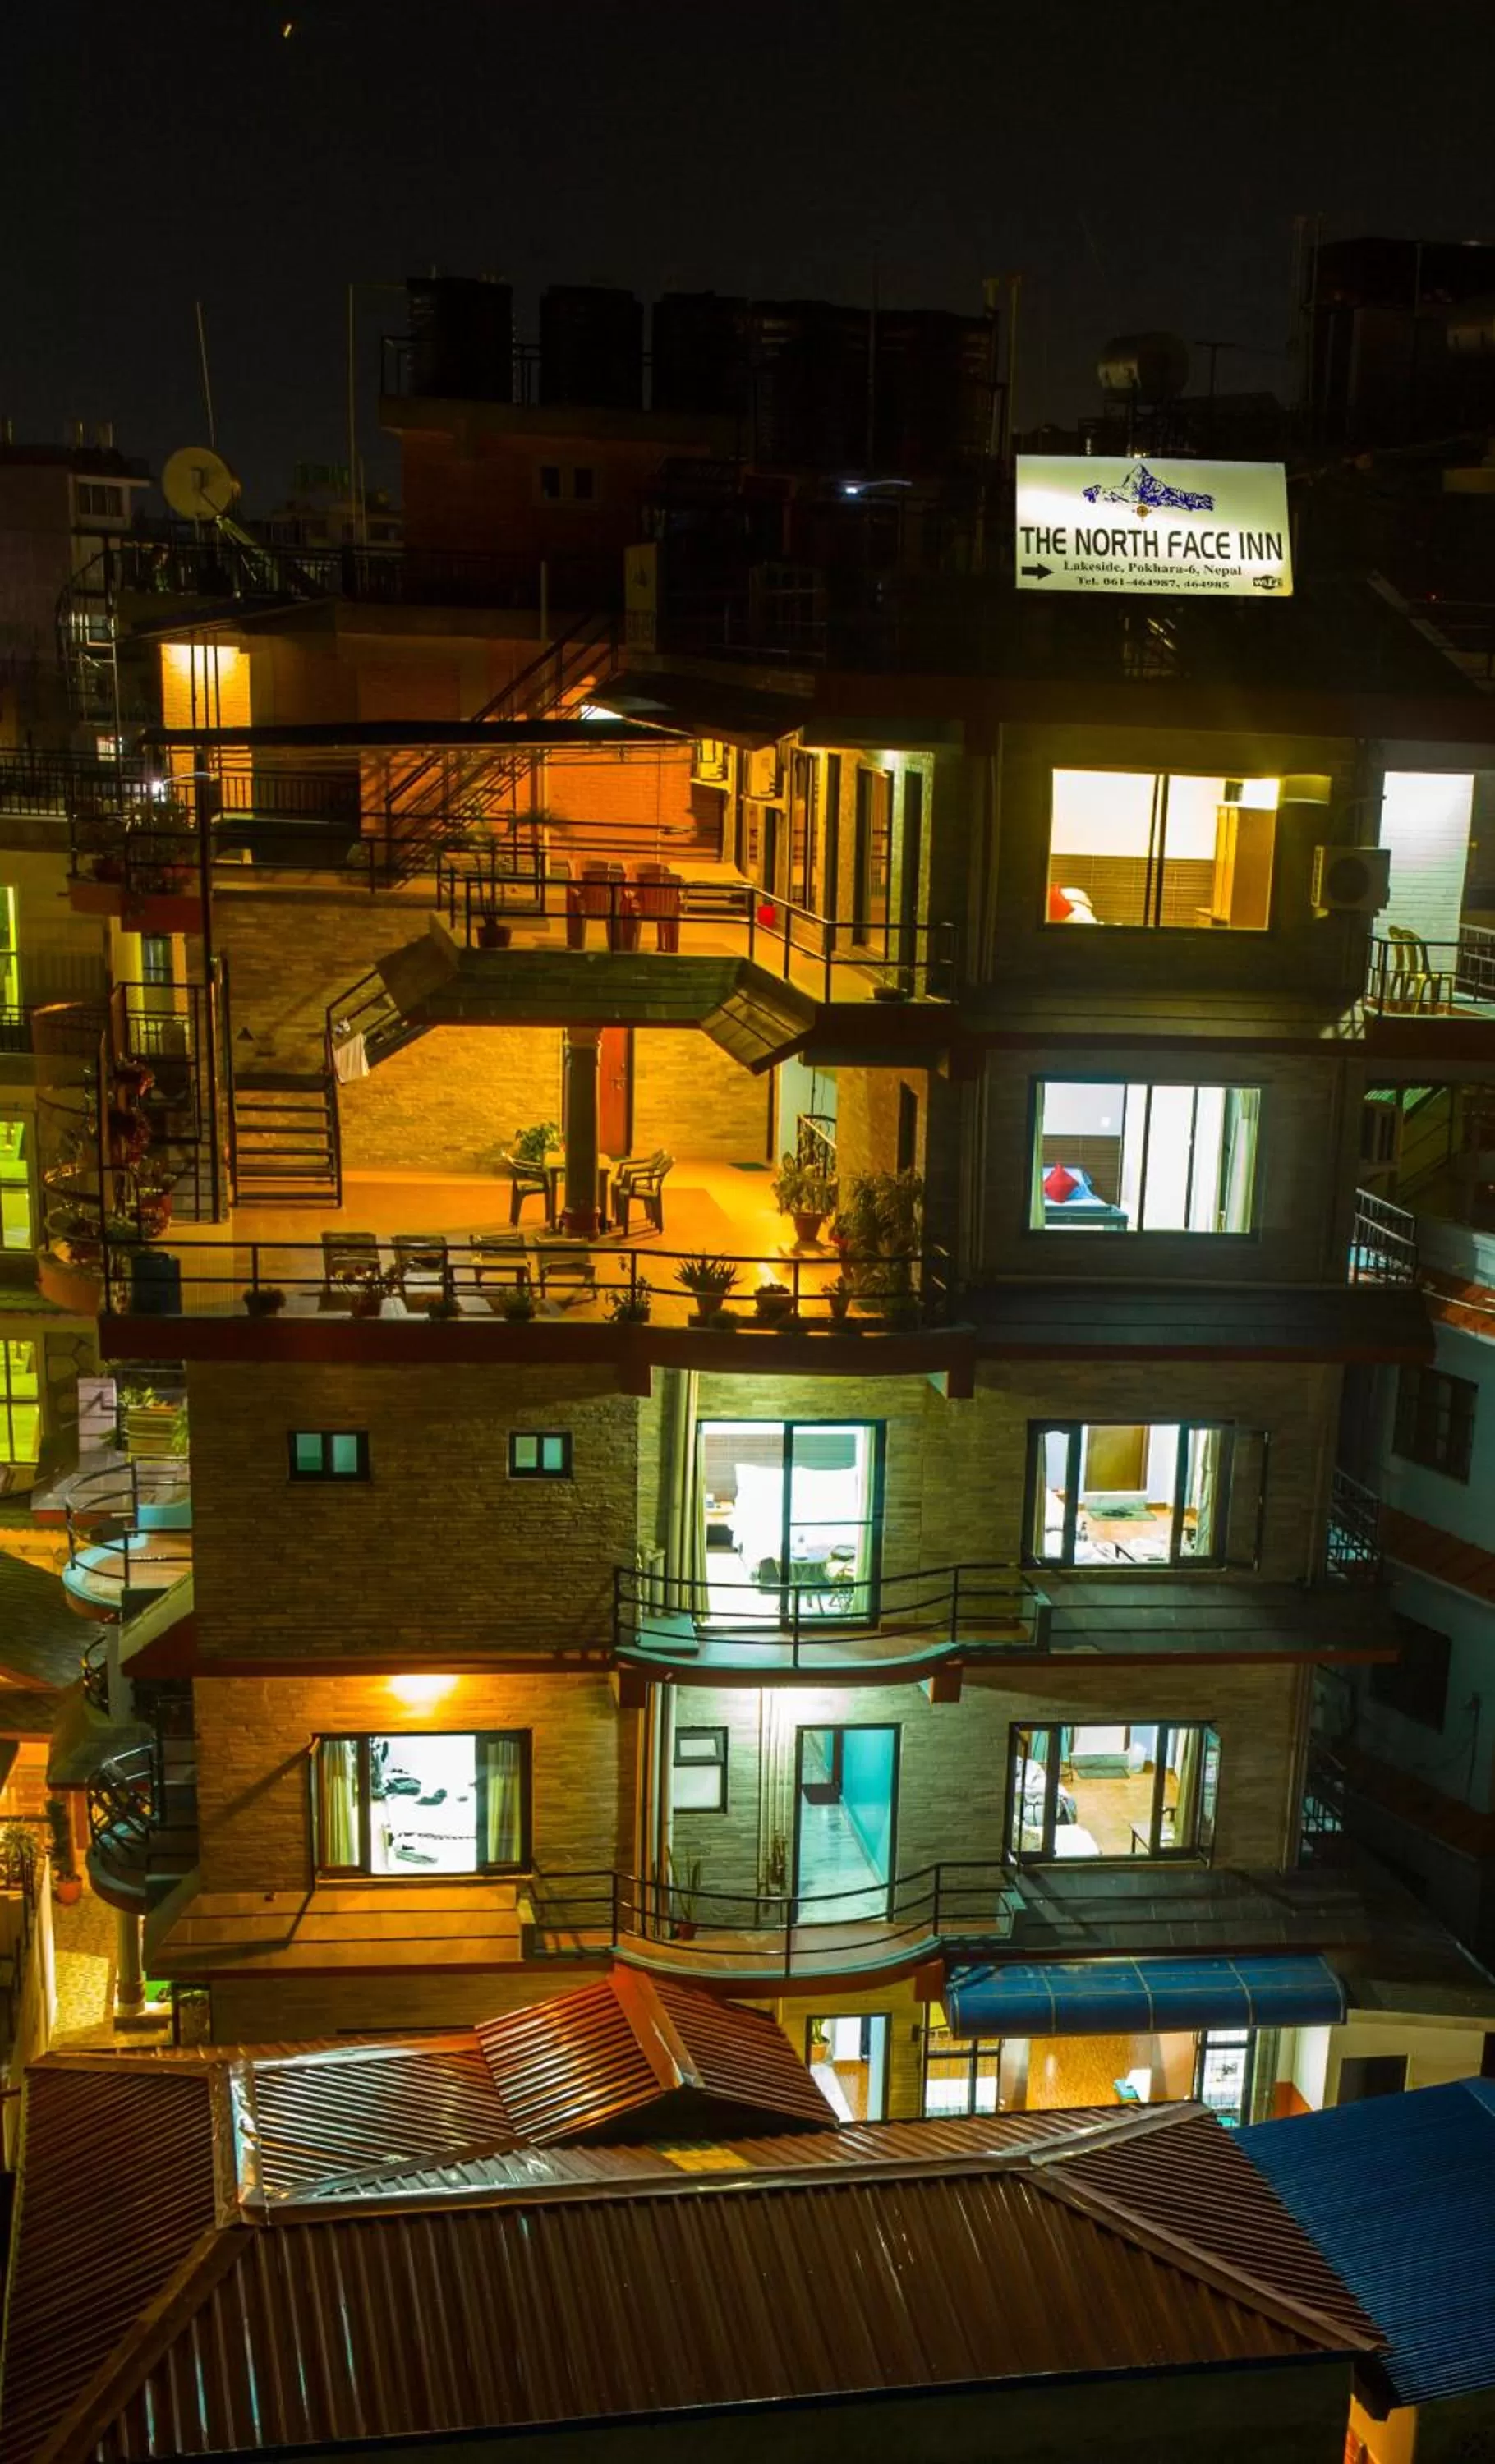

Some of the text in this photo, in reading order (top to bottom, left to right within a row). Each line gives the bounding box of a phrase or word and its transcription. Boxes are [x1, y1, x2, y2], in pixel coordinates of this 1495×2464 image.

[1020, 527, 1283, 560] THE NORTH FACE INN
[1063, 560, 1242, 577] Lakeside, Pokhara-6, Nepal
